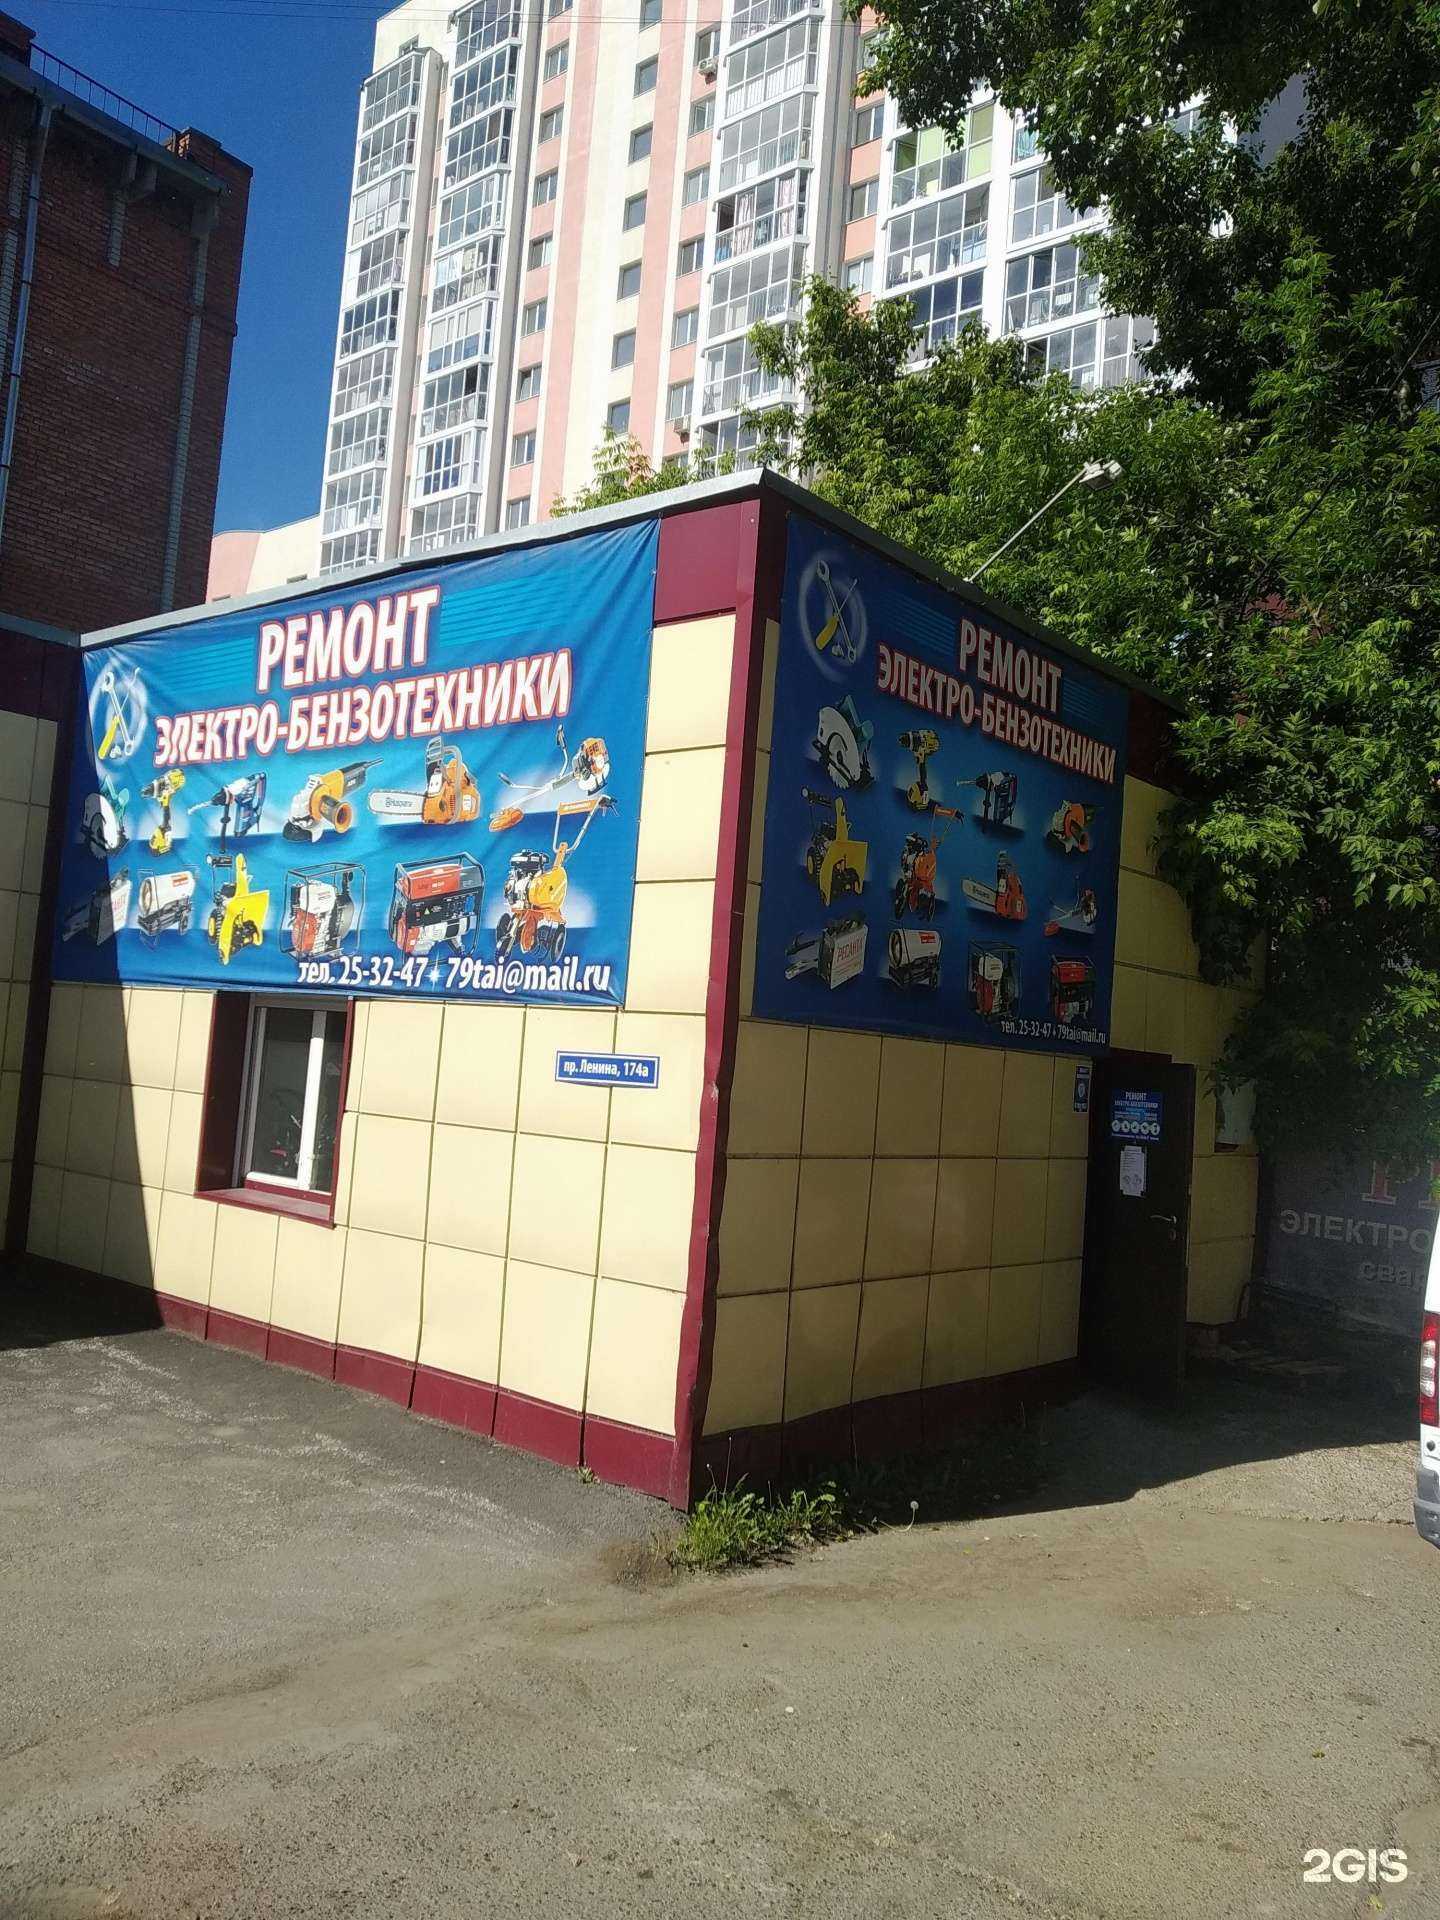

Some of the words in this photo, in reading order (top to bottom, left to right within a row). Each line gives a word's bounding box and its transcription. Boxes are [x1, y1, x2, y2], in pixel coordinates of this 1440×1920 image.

[258, 587, 441, 693] РЕМОНТ
[959, 618, 1063, 713] РЕМОНТ
[153, 649, 572, 767] ЭЛЕКТРО-БЕНЗОТЕХНИКИ
[877, 643, 1118, 785] ЭЛЕКТРО-БЕНЗОТЕХНИКИ
[298, 961, 335, 984] тел.
[338, 955, 429, 987] 25-32-47
[446, 955, 610, 993] 79tai@mail.ru
[563, 1060, 579, 1076] пр.
[579, 1058, 621, 1077] Ленина,
[623, 1062, 649, 1077] 174а
[1001, 1019, 1017, 1035] тел.
[1019, 1019, 1052, 1038] 25-32-47
[1057, 1023, 1107, 1044] 79tai@mail.ru
